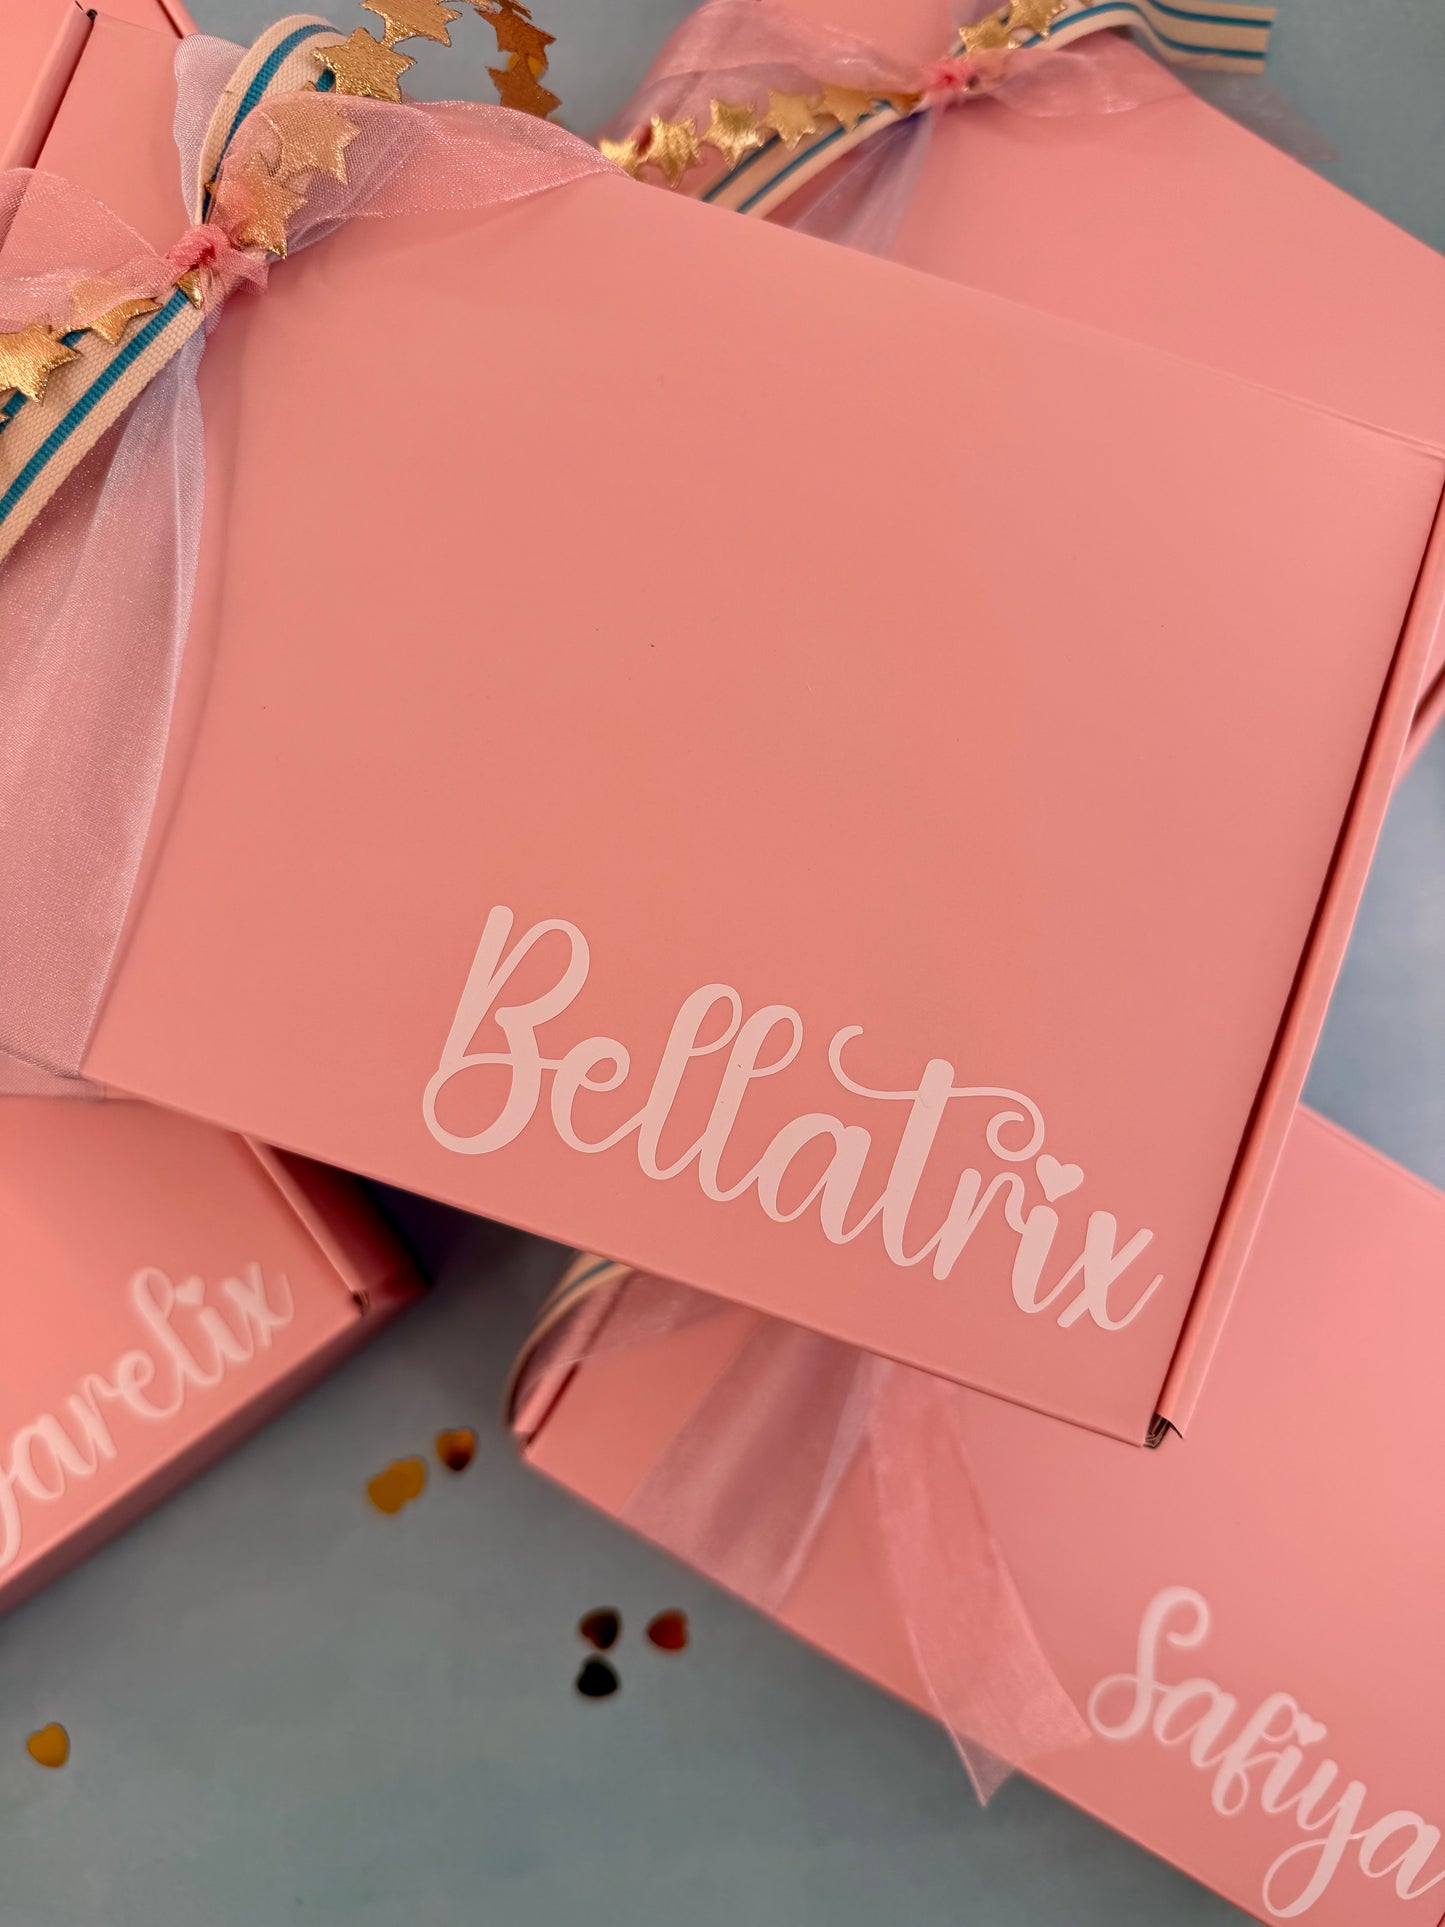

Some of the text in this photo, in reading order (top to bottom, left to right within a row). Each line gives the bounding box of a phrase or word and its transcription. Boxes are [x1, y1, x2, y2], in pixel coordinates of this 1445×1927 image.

[423, 904, 1164, 1331] Bellatrix
[0, 1261, 294, 1566] arelix
[1088, 1585, 1445, 1918] Safiya
